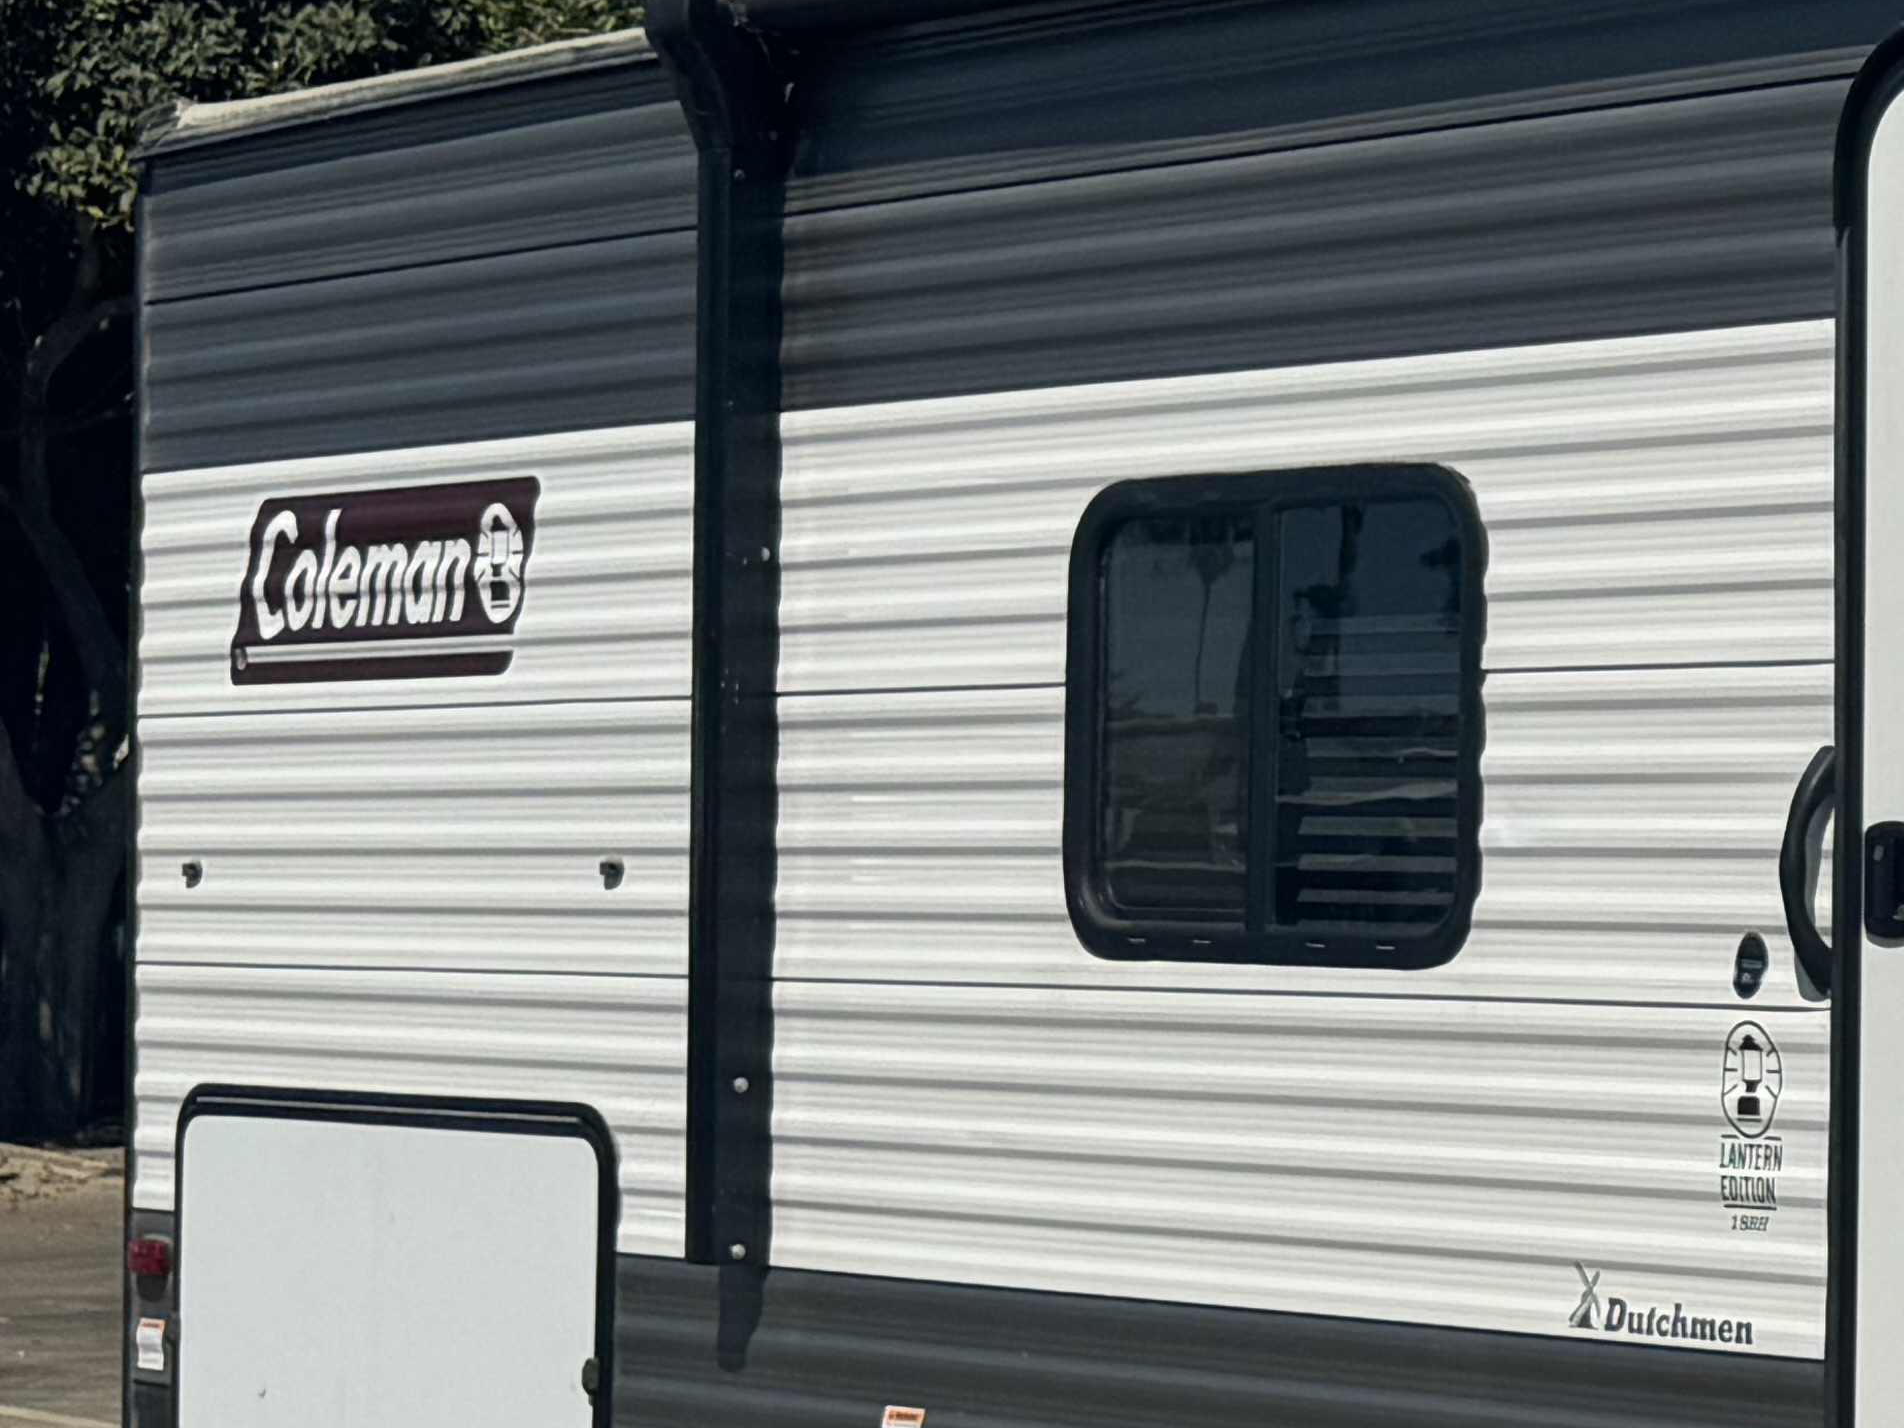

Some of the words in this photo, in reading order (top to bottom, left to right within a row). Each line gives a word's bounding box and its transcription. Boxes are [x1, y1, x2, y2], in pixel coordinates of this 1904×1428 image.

[253, 508, 472, 640] Coleman
[1719, 1142, 1783, 1172] LANTERN
[1720, 1174, 1777, 1204] EDITION
[1604, 1297, 1754, 1345] Dutchmen
